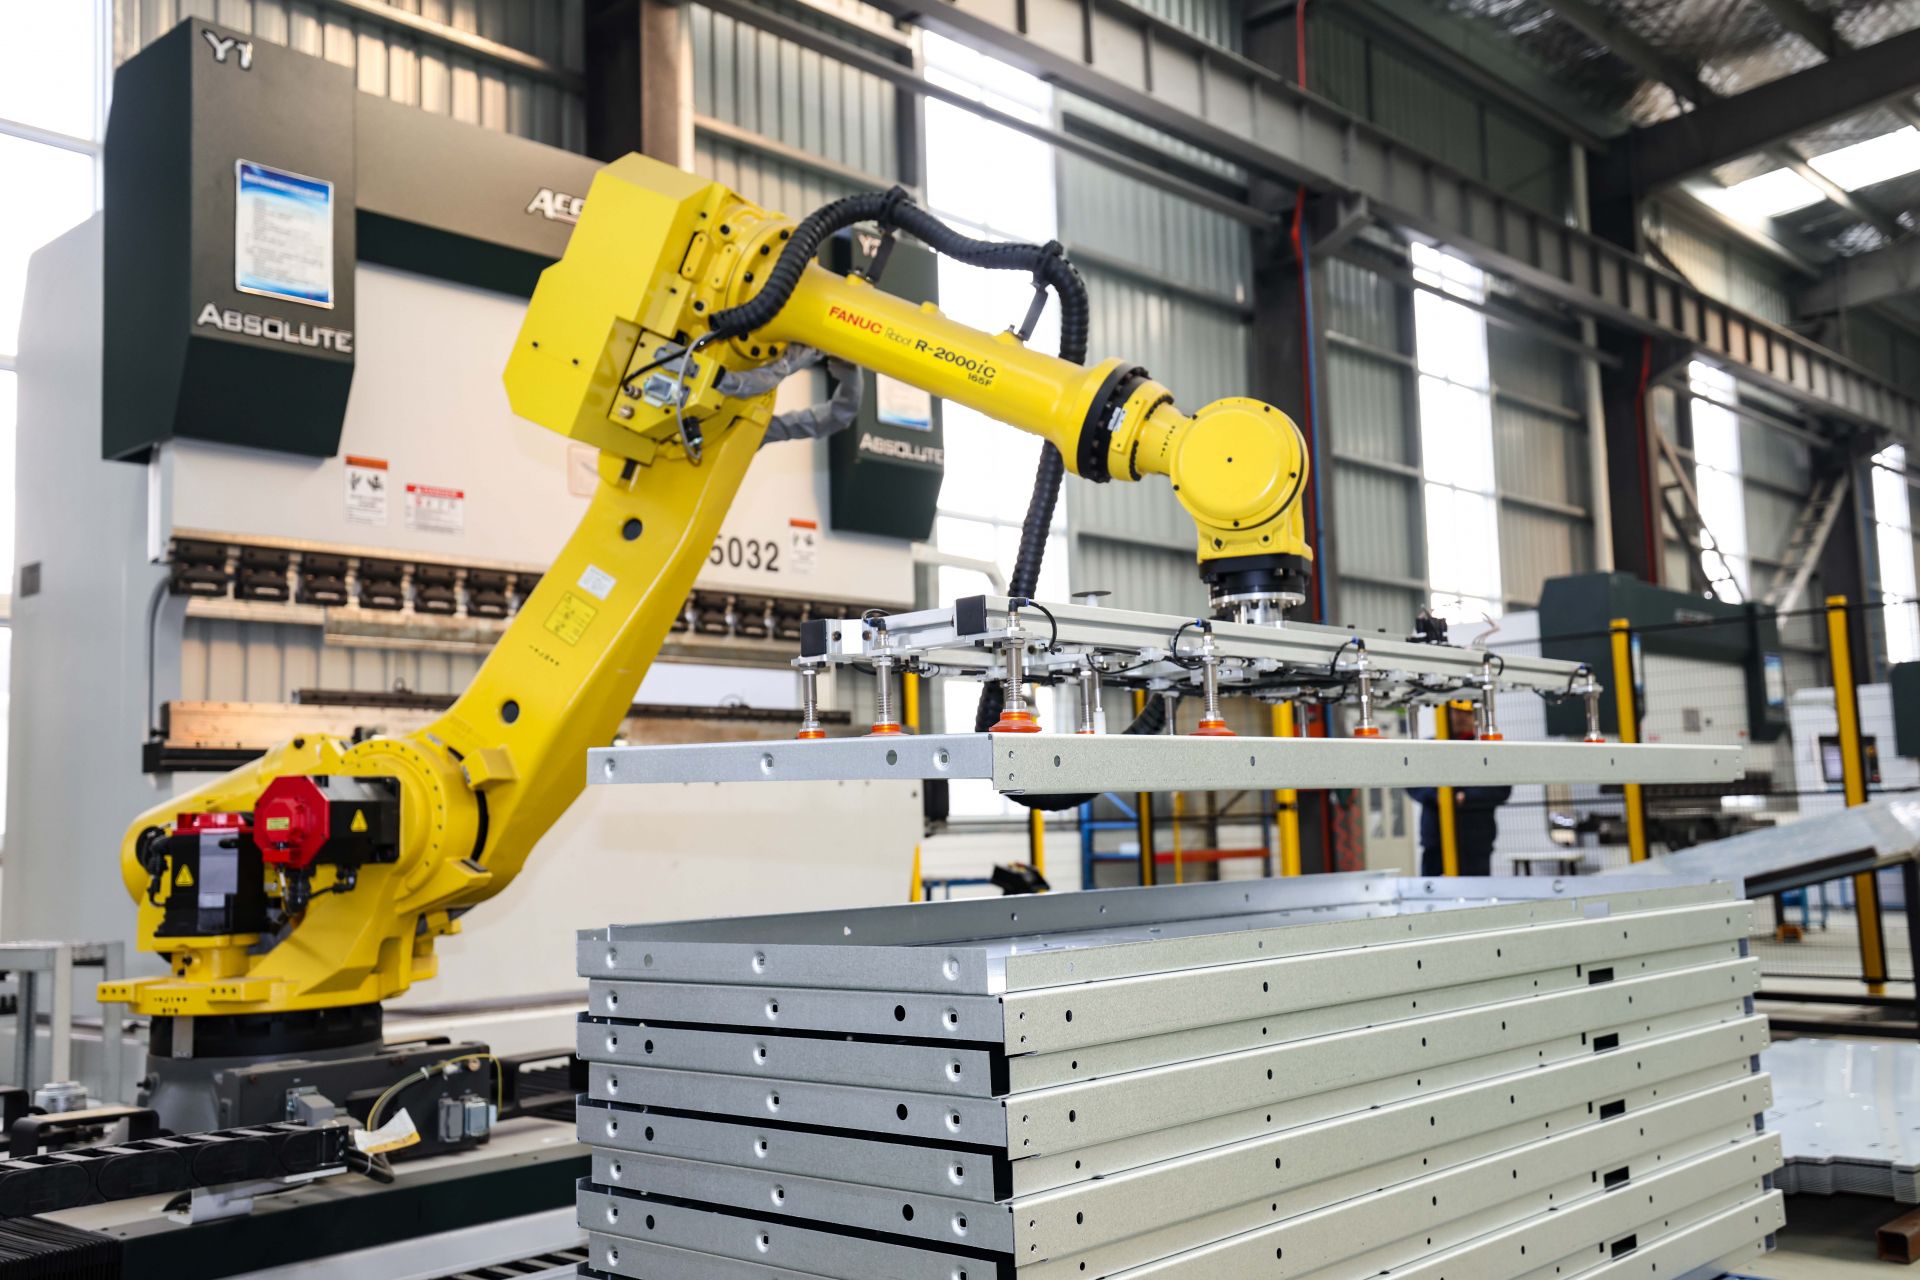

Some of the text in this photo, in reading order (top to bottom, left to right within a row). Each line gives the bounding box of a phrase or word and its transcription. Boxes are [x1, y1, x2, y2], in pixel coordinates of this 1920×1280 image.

[202, 30, 253, 69] Y1
[197, 303, 353, 353] ABSOLUTE
[829, 306, 882, 334] FANUC
[884, 327, 912, 346] Robot
[860, 432, 944, 464] ABSOLUTE
